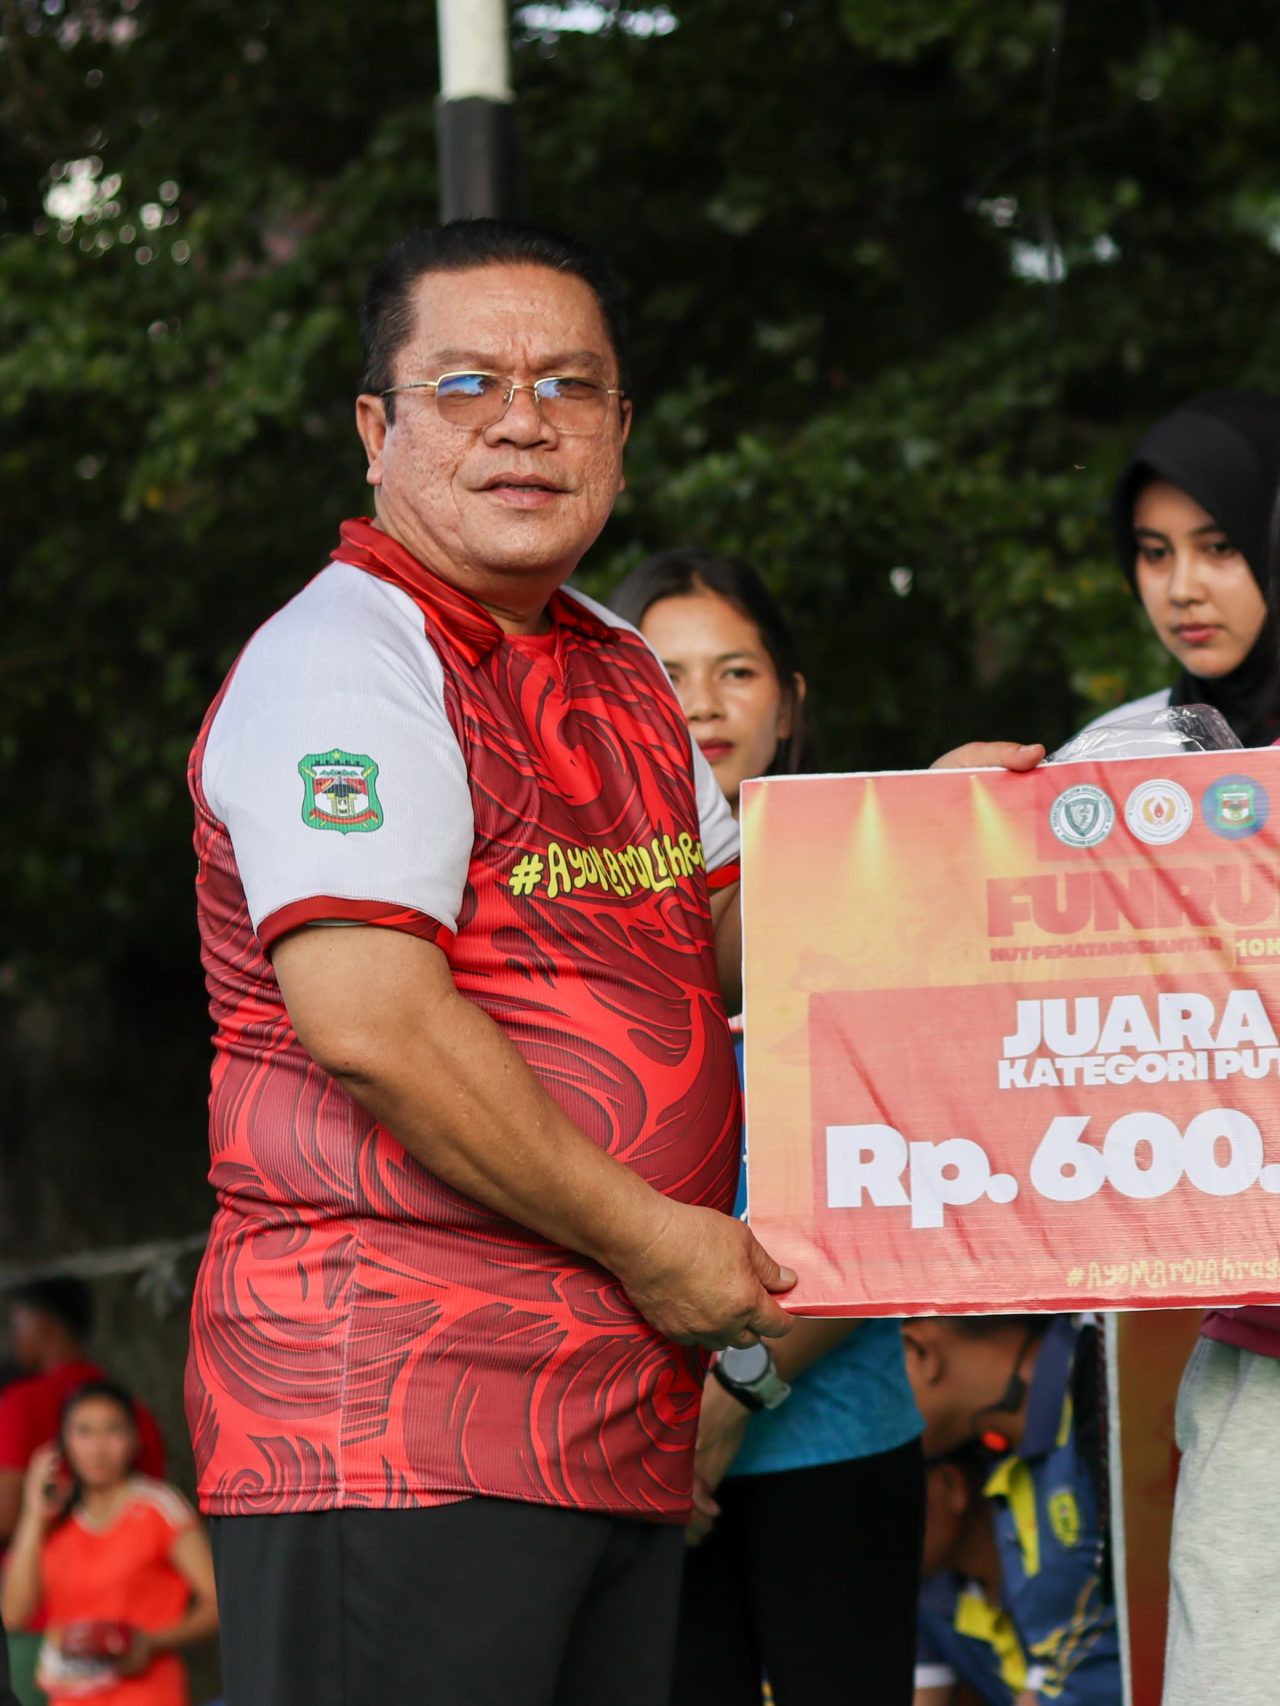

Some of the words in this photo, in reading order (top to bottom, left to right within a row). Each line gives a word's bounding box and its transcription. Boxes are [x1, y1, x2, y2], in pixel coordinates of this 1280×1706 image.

[1003, 990, 1279, 1058] JUARA
[998, 1051, 1209, 1089] KATEGORI
[825, 1123, 1019, 1228] Rp.
